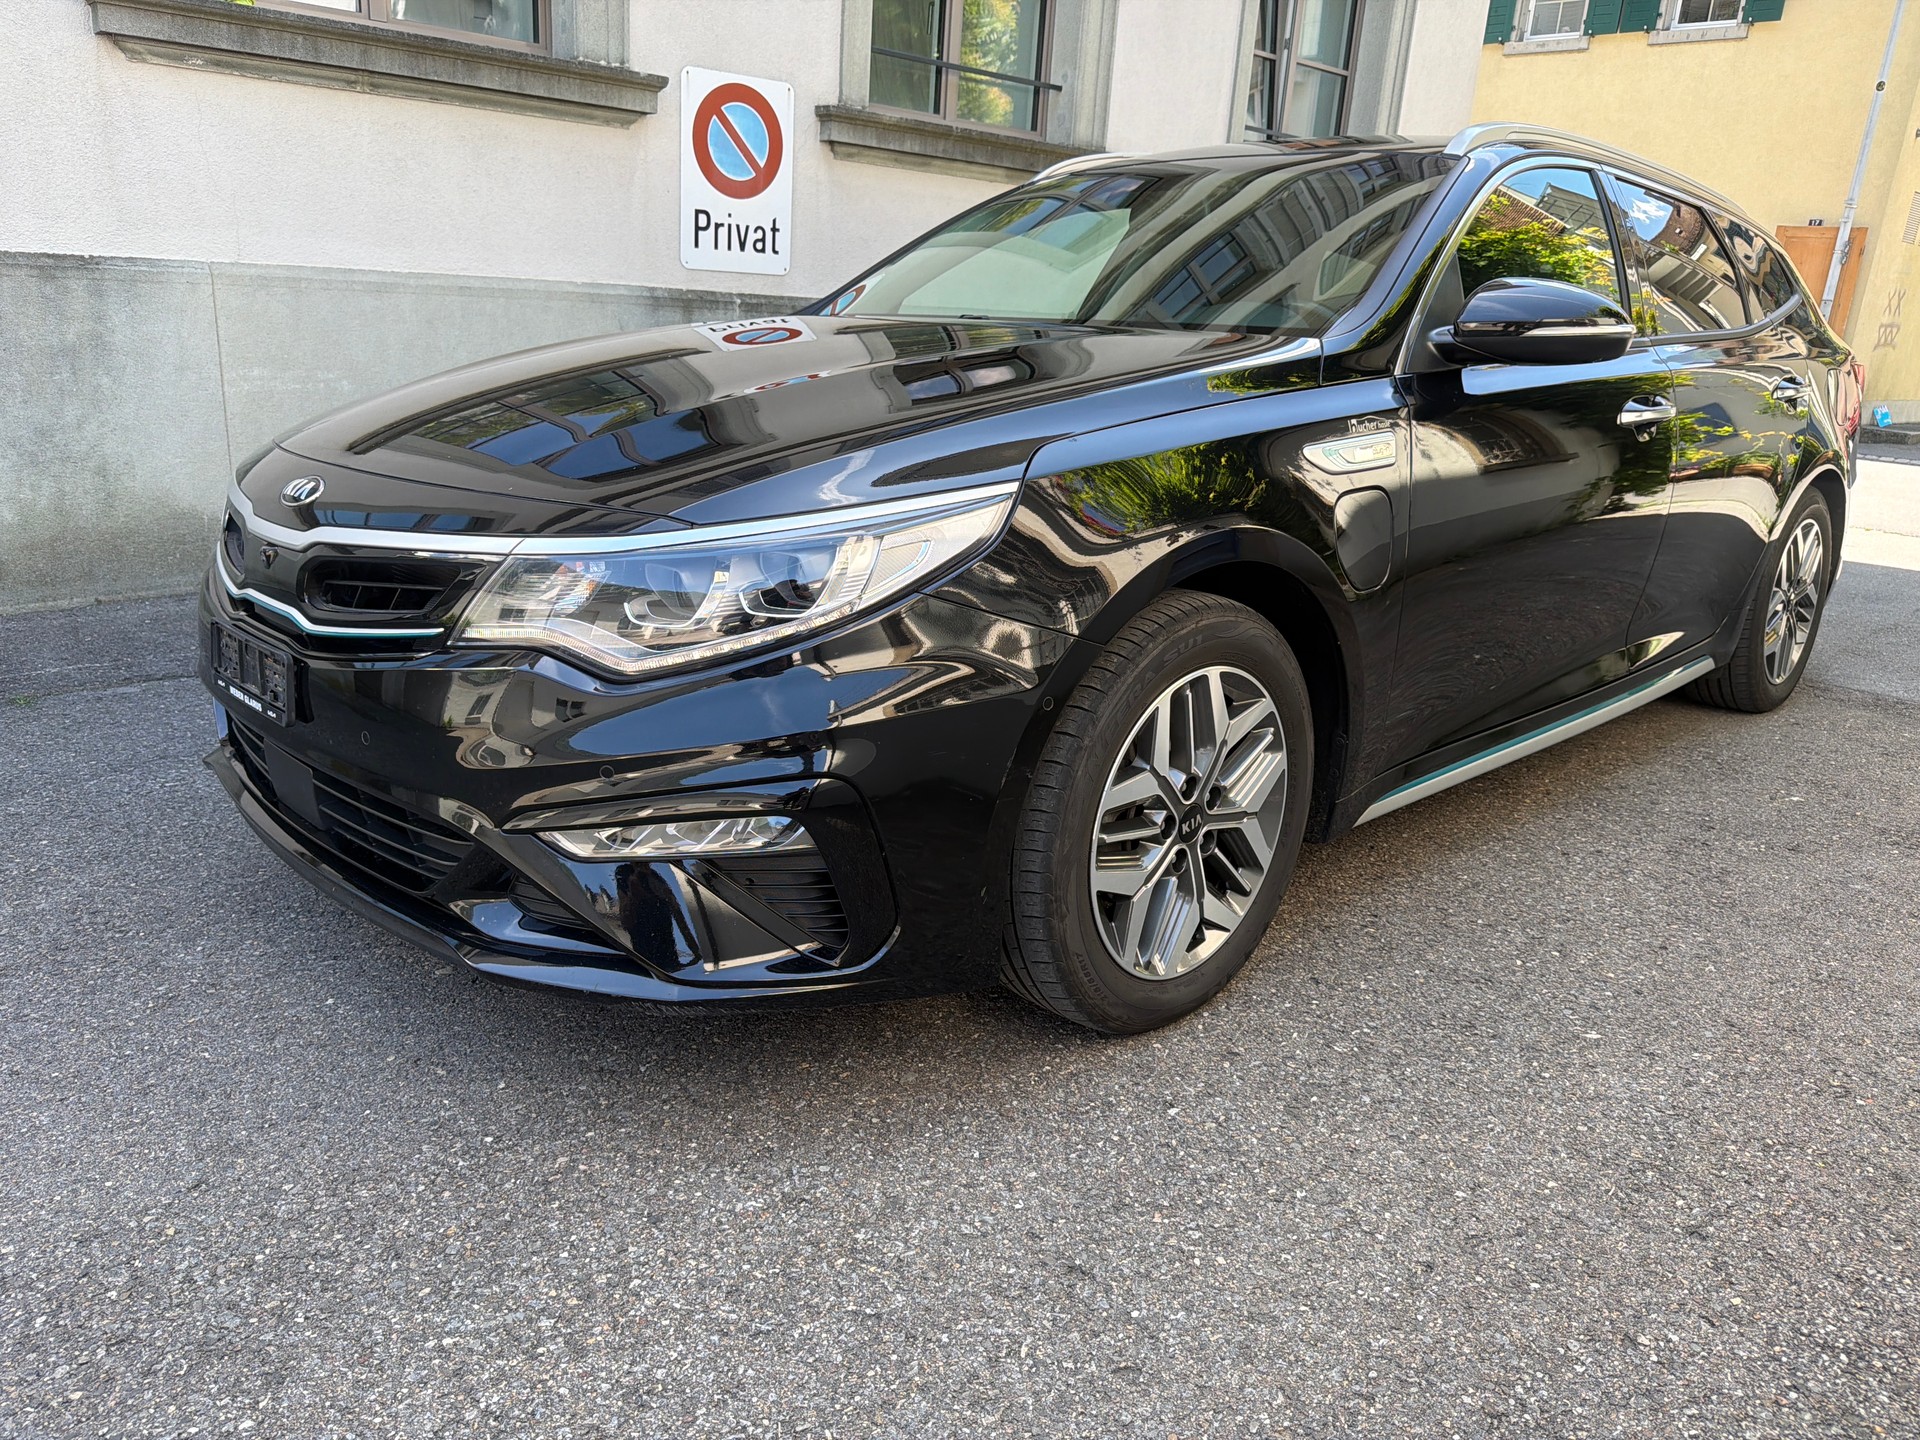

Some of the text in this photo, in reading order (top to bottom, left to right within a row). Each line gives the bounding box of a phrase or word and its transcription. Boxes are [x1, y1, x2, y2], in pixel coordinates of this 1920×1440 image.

[694, 208, 780, 255] Privat
[283, 479, 317, 500] KIA
[1181, 814, 1202, 835] KIA
